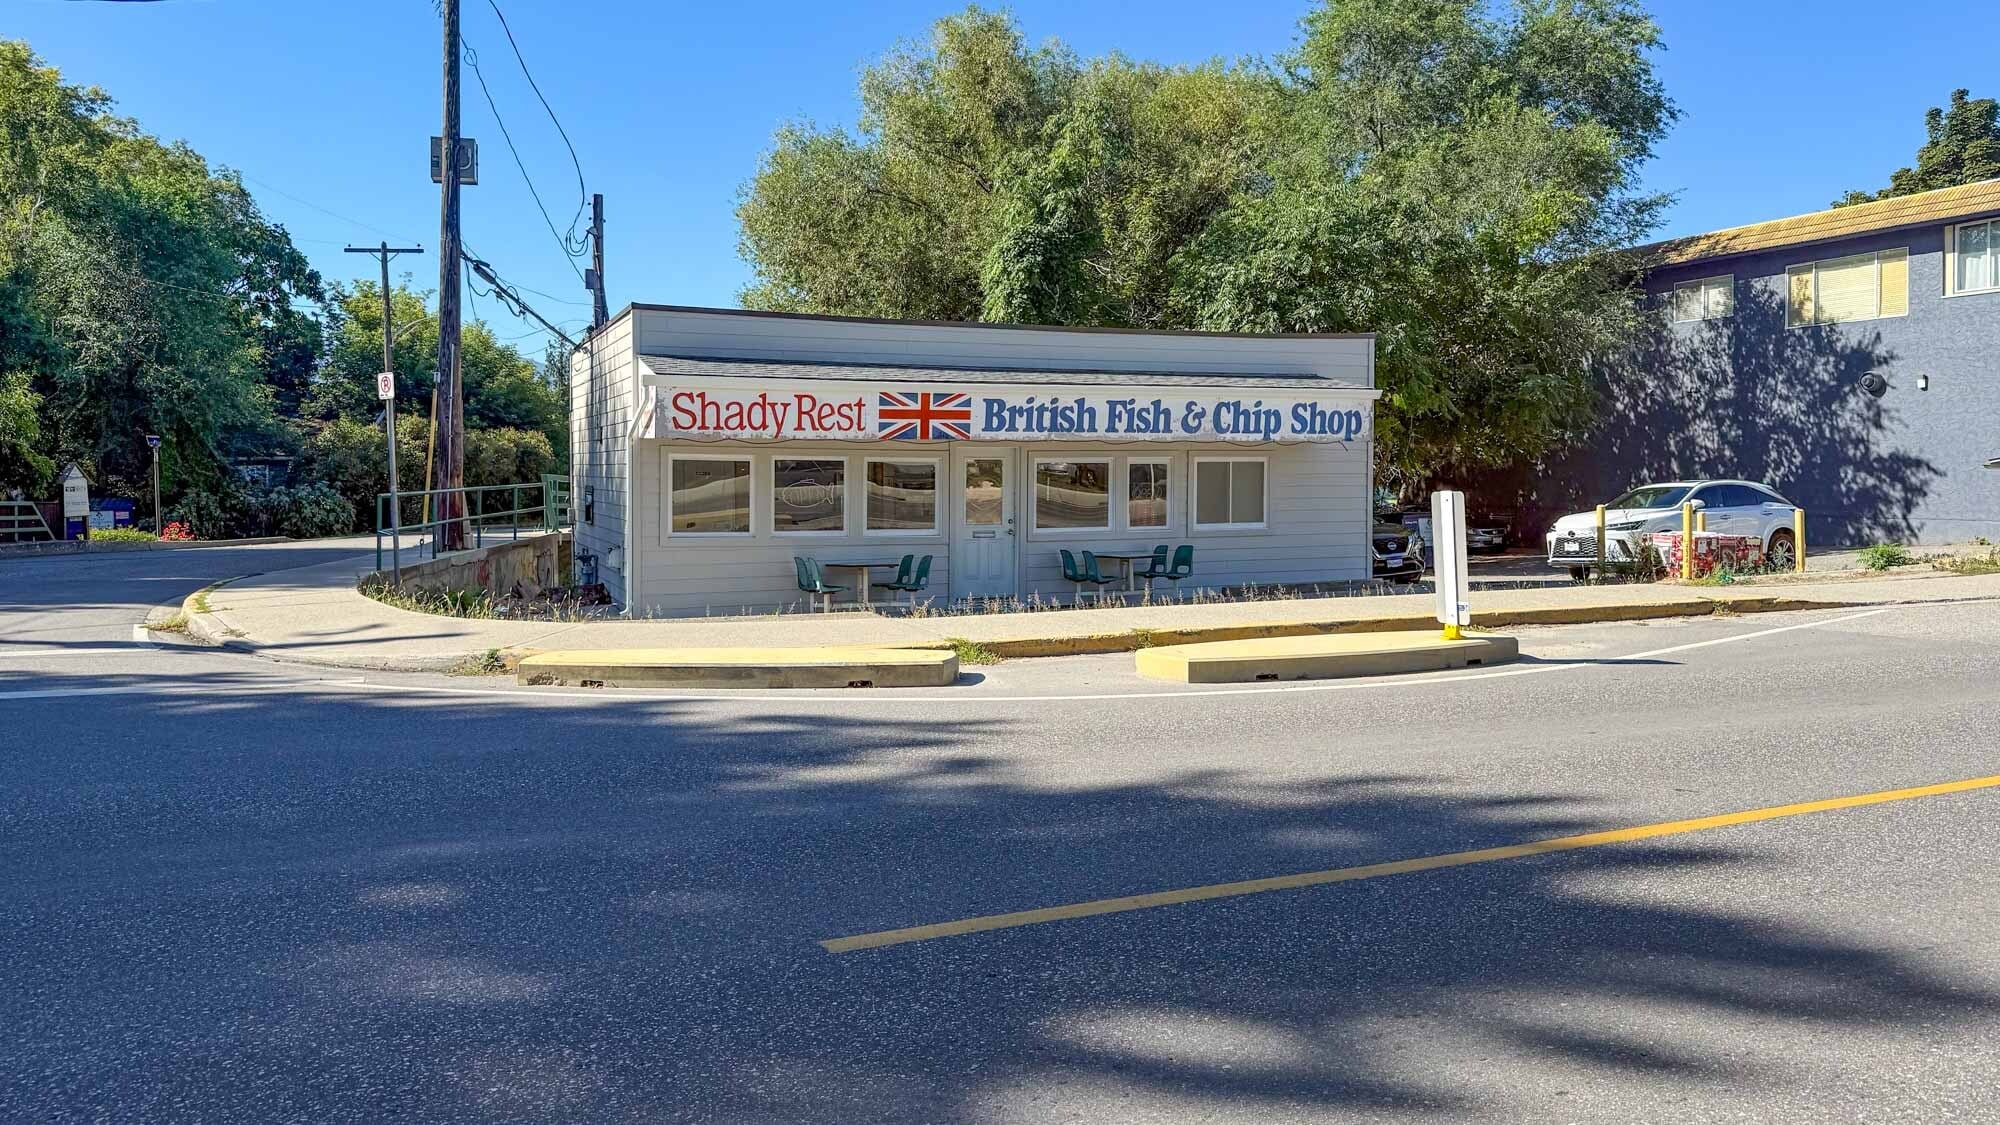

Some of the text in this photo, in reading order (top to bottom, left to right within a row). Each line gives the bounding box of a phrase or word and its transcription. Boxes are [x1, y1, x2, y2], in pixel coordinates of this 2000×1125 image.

[671, 391, 1362, 442] Shady Rest British Fish & Chip Shop
